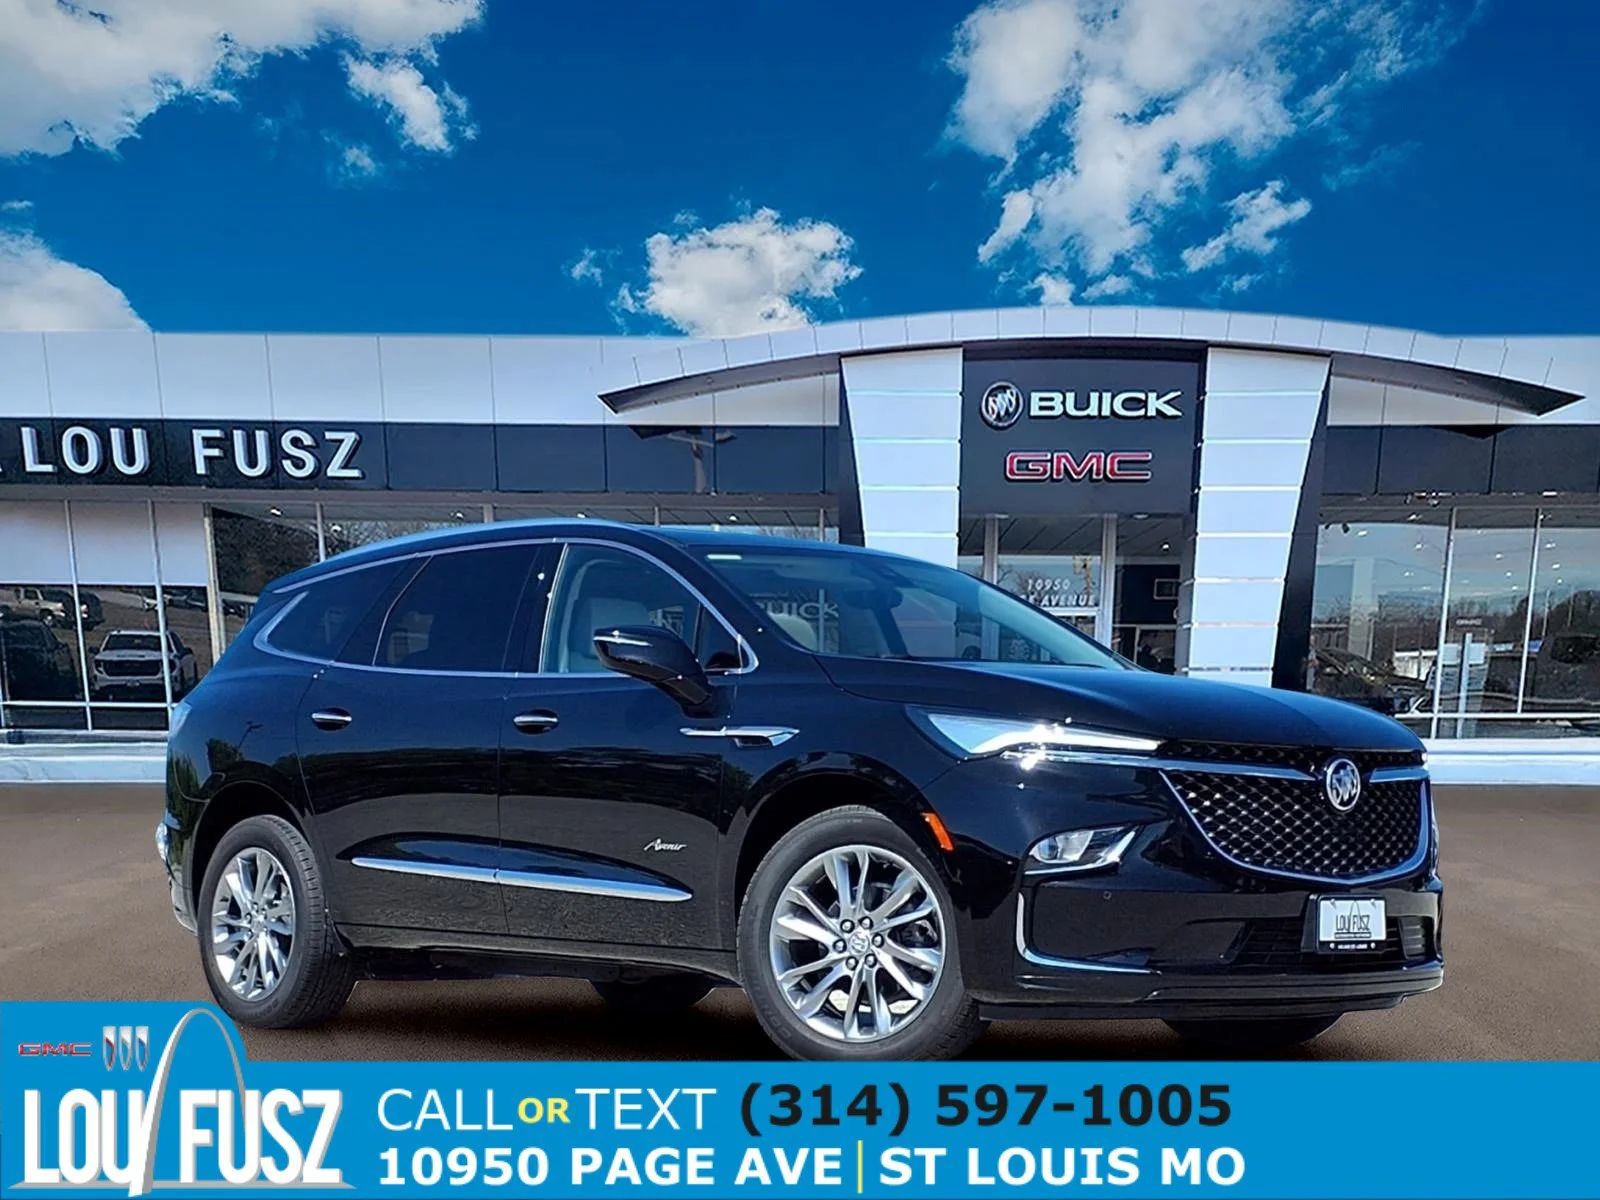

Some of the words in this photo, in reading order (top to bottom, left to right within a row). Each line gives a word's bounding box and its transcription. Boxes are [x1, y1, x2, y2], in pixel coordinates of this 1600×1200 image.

[1029, 391, 1183, 417] BUICK
[20, 426, 150, 476] LOU
[191, 428, 363, 479] FUSZ
[1006, 451, 1152, 480] GMC
[1027, 579, 1071, 591] 10950
